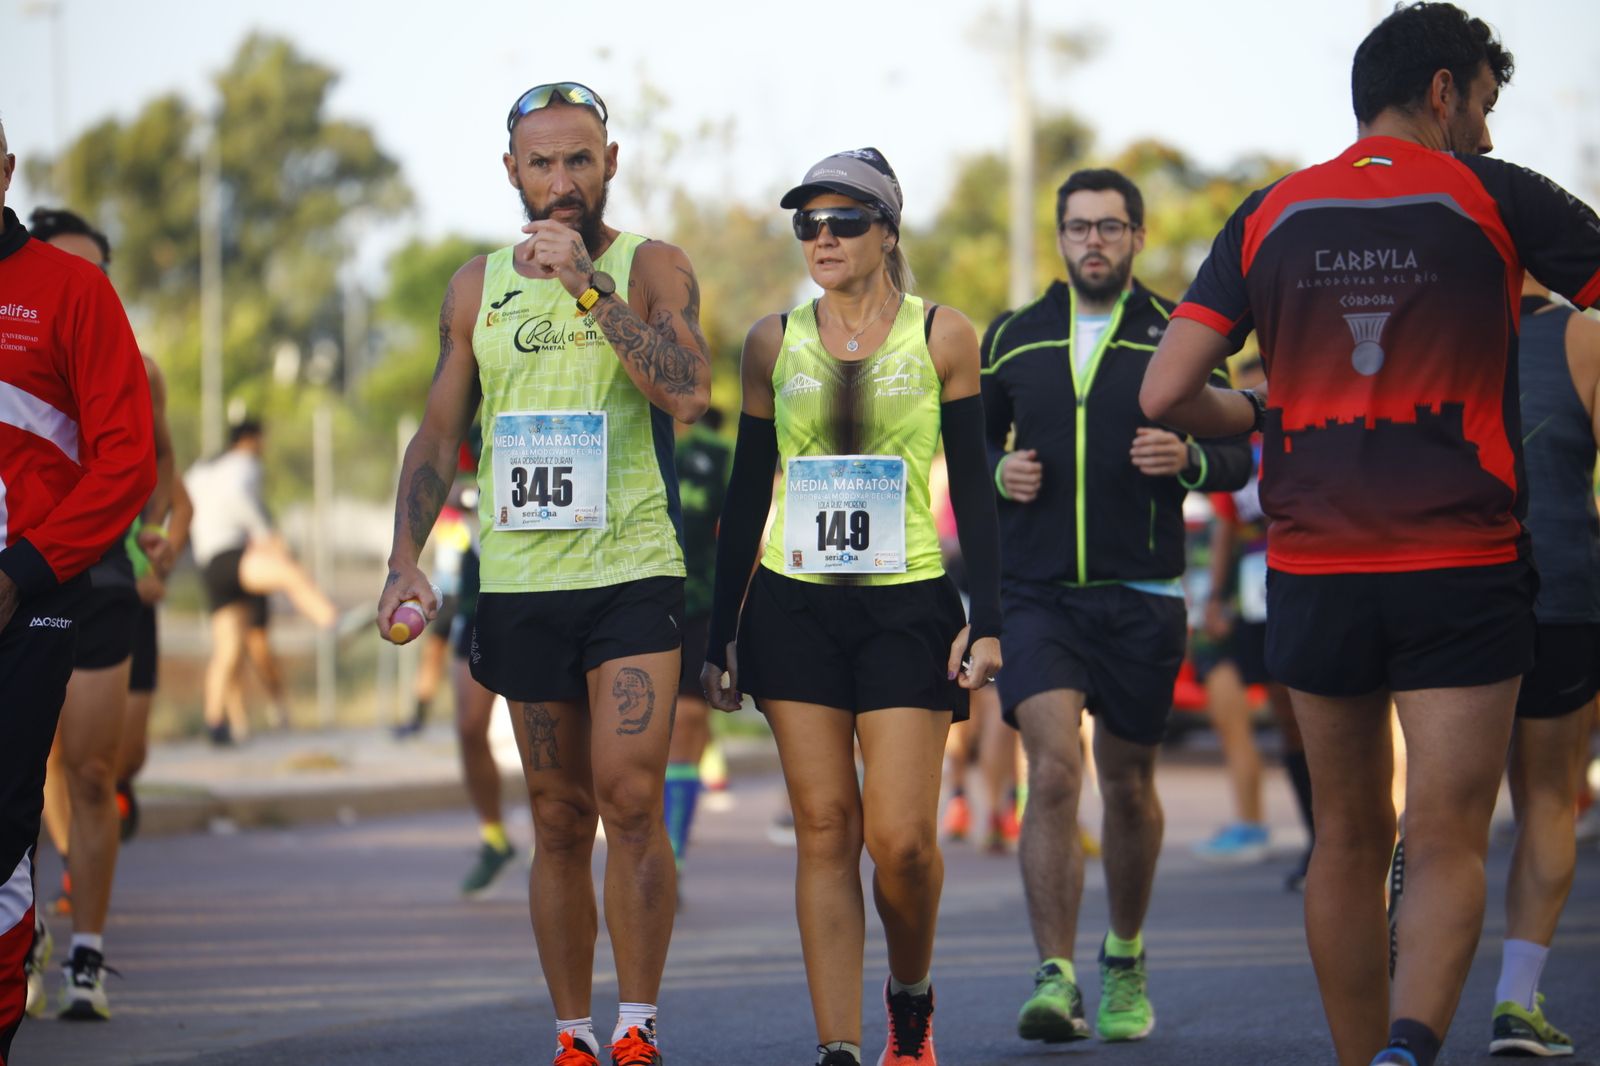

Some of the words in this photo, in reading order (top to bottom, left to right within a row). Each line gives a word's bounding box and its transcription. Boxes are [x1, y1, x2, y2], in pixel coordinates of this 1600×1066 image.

[1383, 274, 1406, 284] DEL
[495, 434, 526, 447] MEDIA
[532, 431, 601, 446] MARATÓN
[511, 466, 573, 508] 345
[790, 479, 828, 492] MEDIA
[833, 475, 900, 490] MARATÓN
[816, 510, 870, 551] 149
